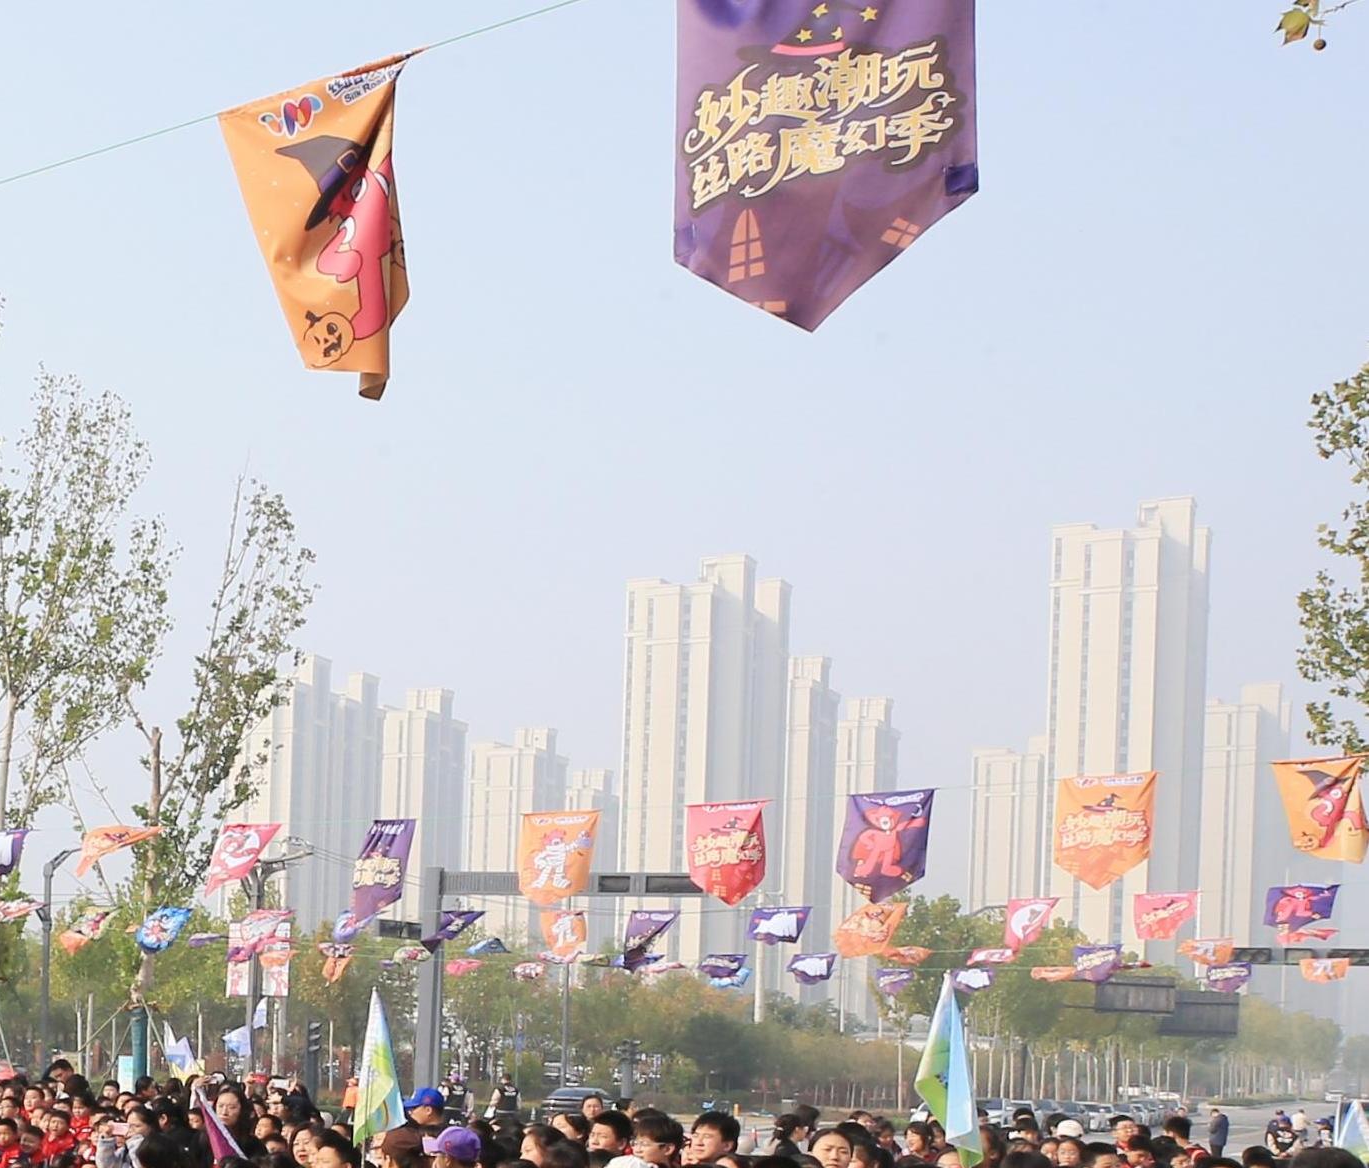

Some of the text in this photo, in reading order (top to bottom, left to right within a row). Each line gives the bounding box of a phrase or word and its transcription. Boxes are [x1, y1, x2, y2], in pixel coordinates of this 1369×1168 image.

[684, 42, 945, 167] 妙趣潮玩
[692, 91, 957, 209] 丝路魔幻季
